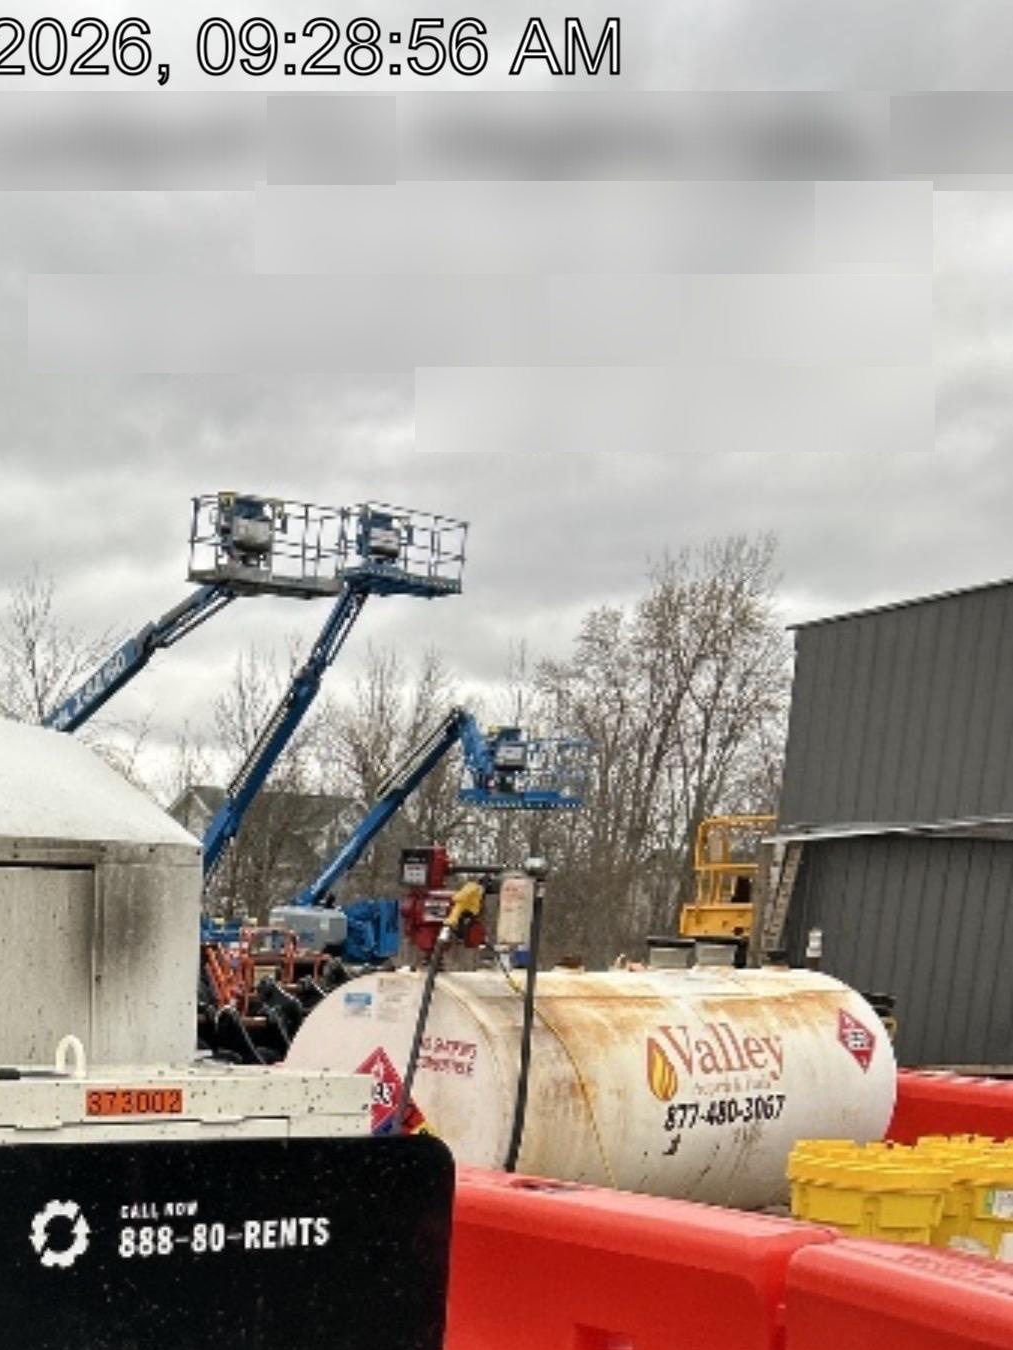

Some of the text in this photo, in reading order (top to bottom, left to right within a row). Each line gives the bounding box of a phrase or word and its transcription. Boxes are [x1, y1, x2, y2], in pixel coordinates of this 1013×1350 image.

[657, 1022, 784, 1080] Valley
[88, 1089, 182, 1115] 373002
[662, 1094, 786, 1132] 877-480-3067
[120, 1201, 199, 1220] CALL NOW
[118, 1216, 331, 1259] 888-80-RENTS
